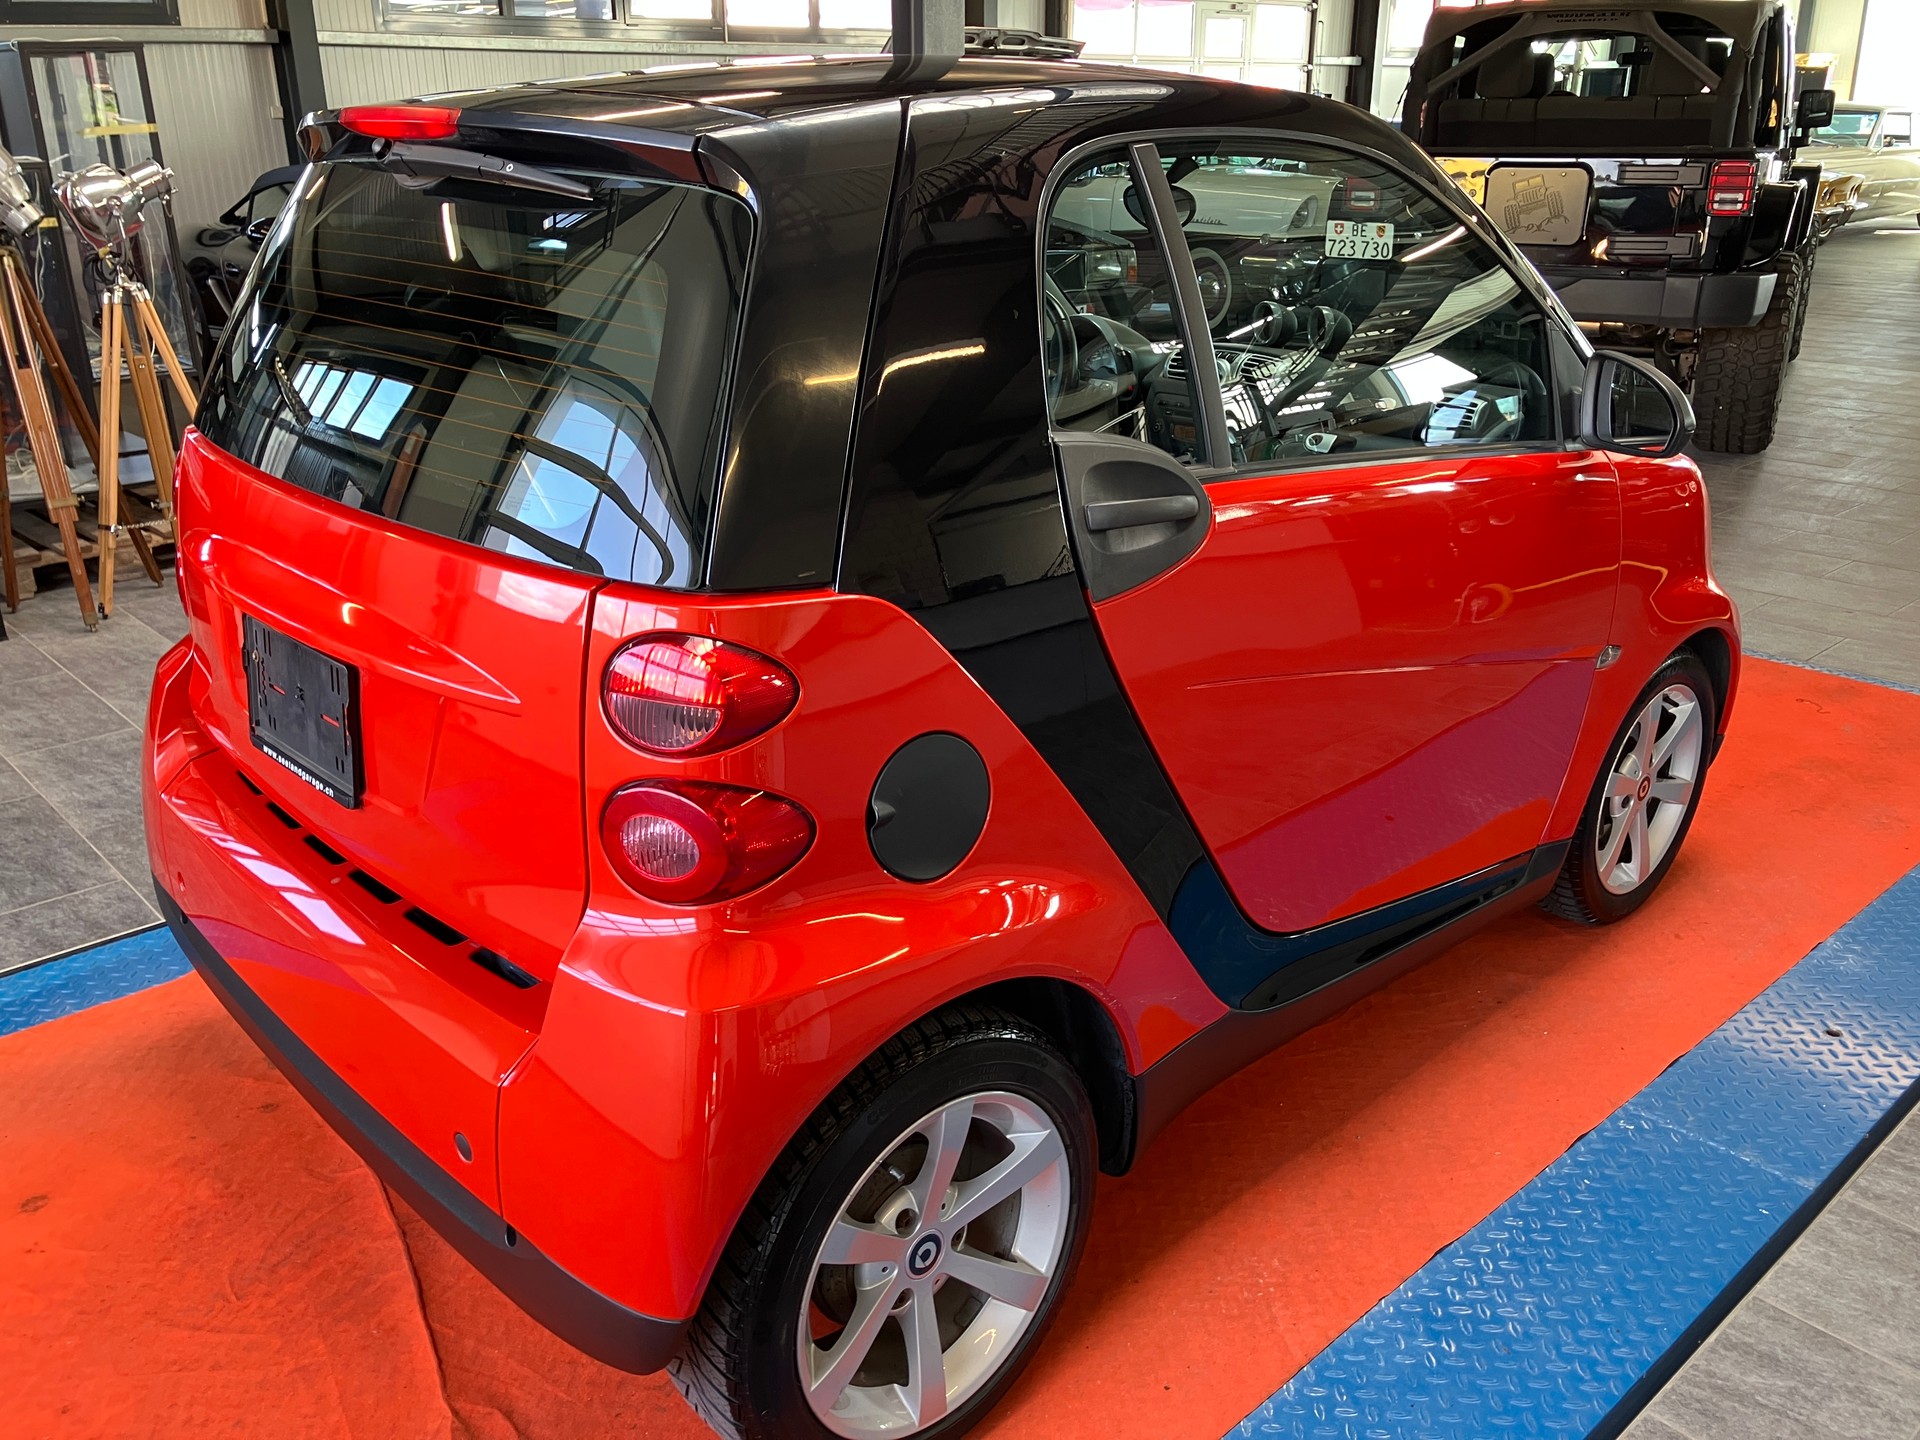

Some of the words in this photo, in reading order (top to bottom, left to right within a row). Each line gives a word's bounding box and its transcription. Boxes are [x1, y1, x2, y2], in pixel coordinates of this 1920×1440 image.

[1351, 224, 1368, 238] BE
[1328, 239, 1356, 257] 723
[1361, 240, 1390, 259] 730
[263, 745, 334, 798] www.seelandgarage.ch
